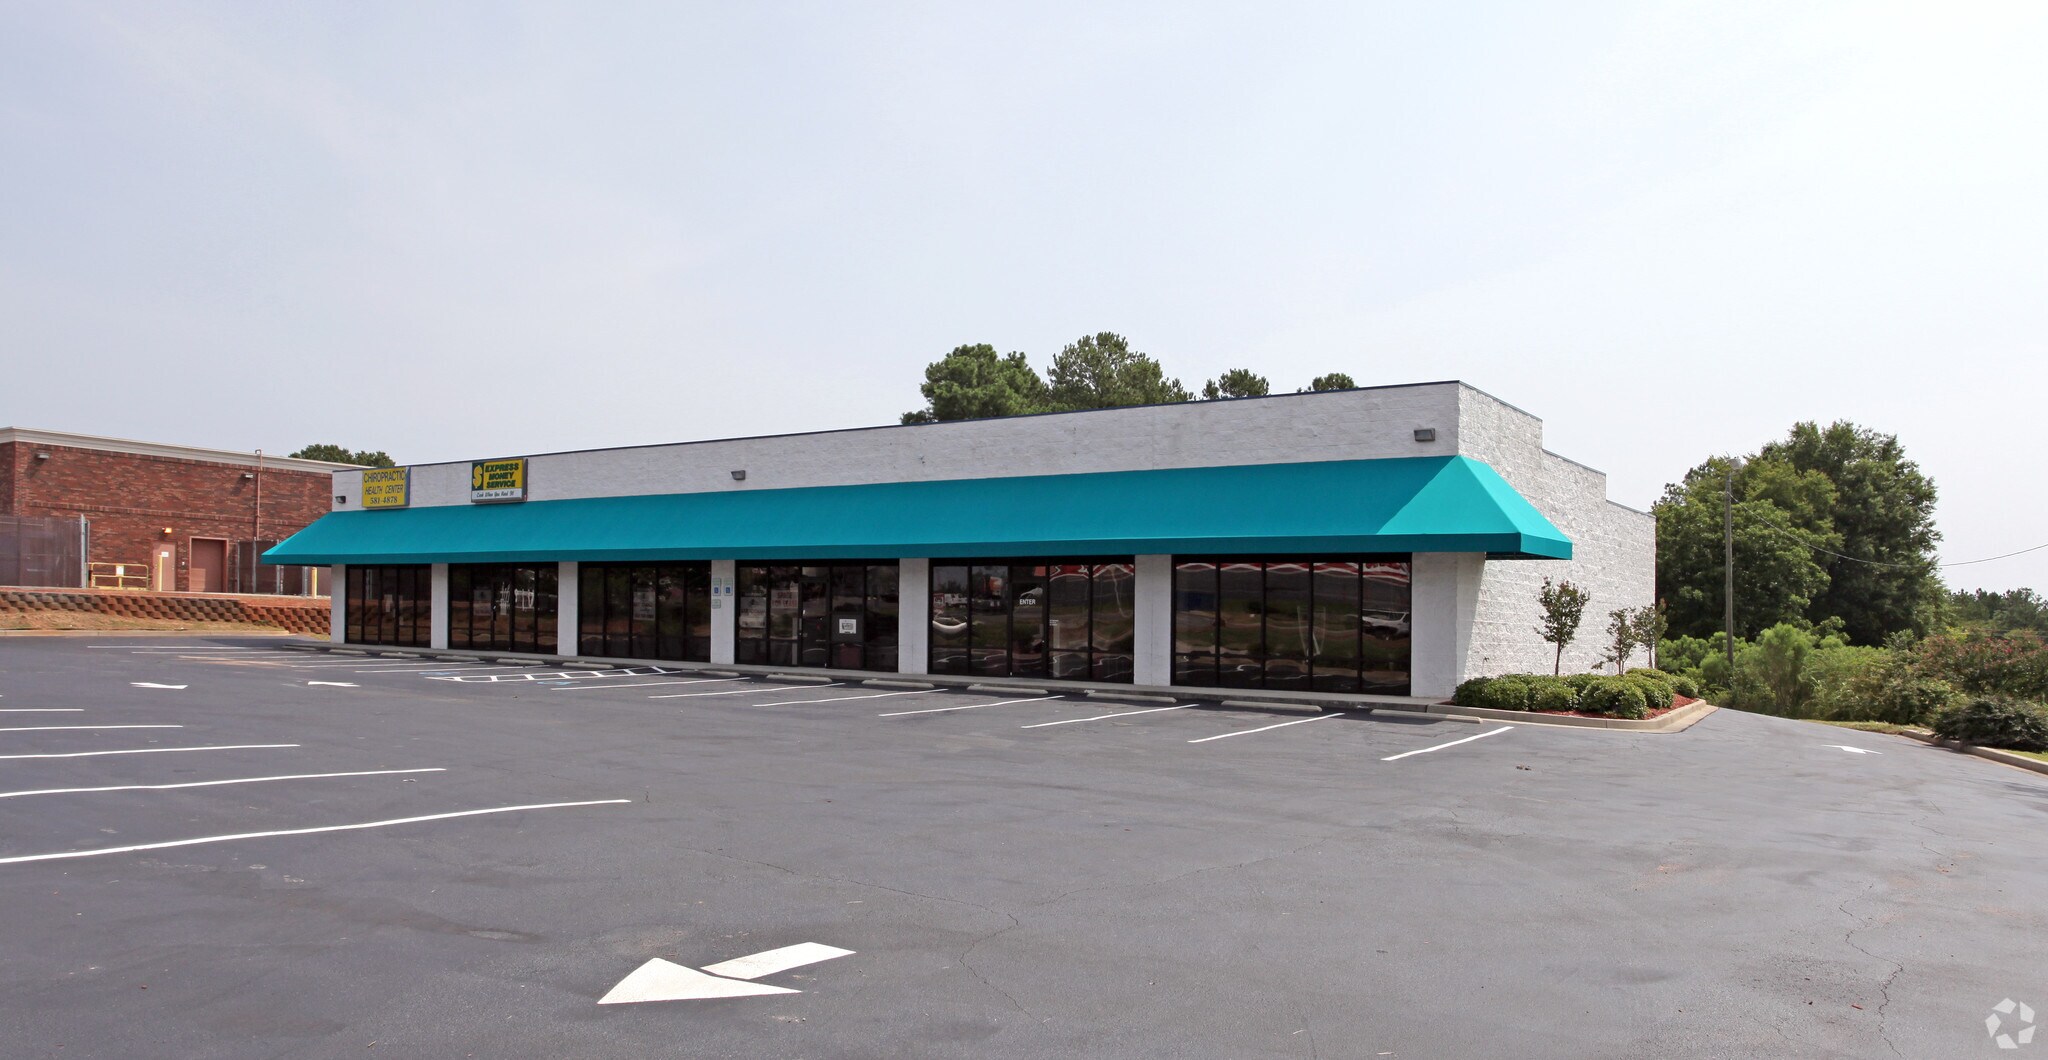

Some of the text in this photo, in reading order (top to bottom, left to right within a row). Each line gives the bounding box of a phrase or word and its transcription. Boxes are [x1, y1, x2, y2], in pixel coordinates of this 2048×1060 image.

[485, 463, 519, 472] EXPRESS
[364, 470, 405, 483] CHIROPRACTIC
[489, 472, 514, 480] MONEY
[487, 480, 516, 488] SERVICE
[365, 484, 404, 495] HEALTH CENTER
